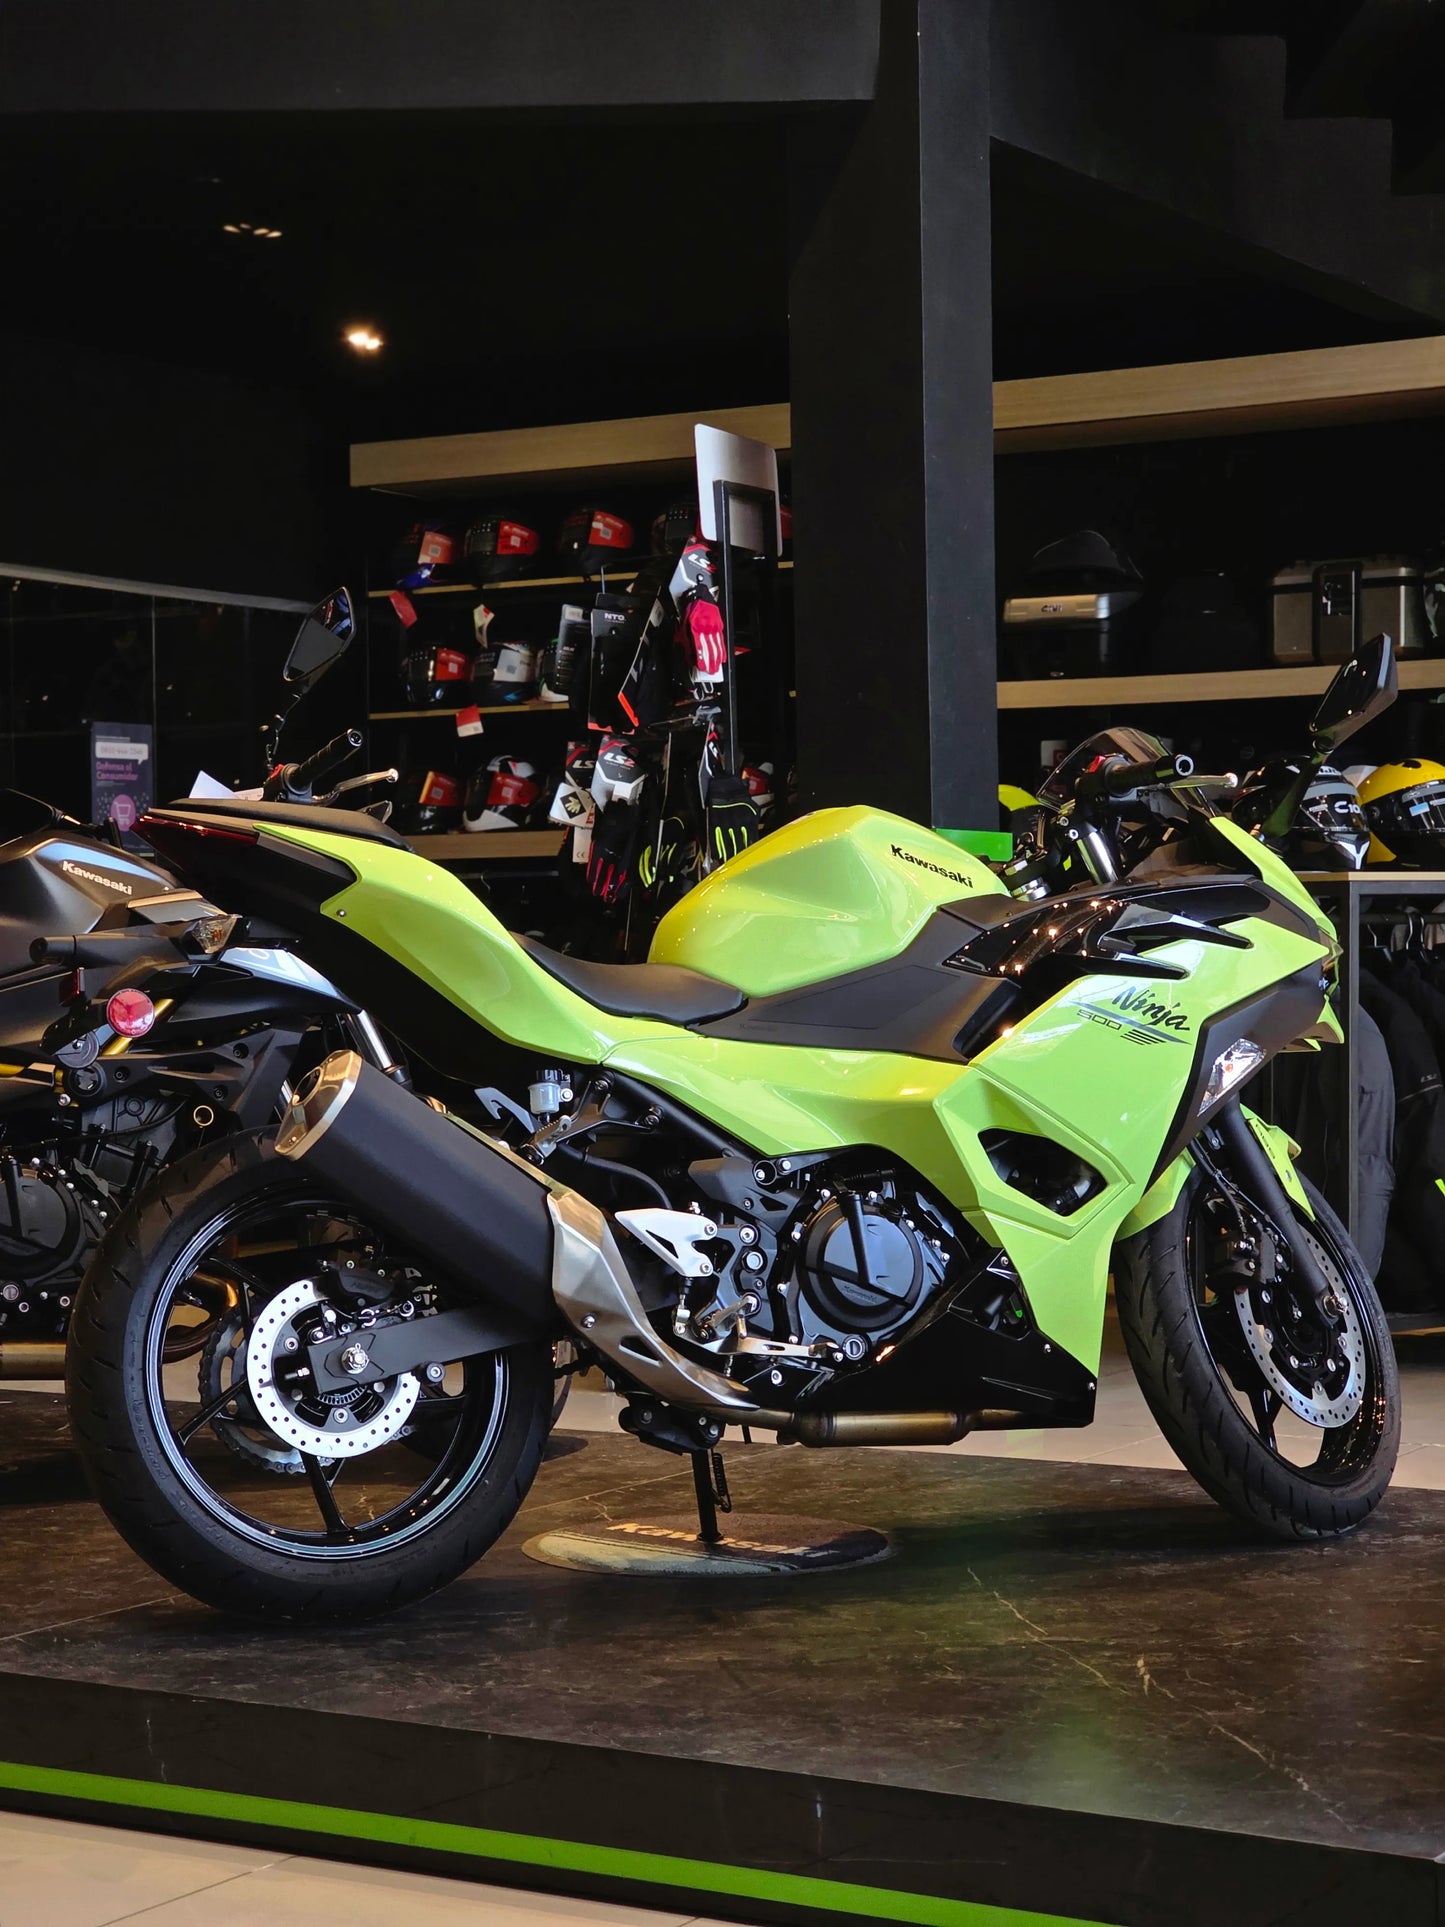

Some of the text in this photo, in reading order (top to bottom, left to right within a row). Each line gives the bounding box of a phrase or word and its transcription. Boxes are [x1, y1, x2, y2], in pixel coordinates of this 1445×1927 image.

[572, 759, 595, 769] LS
[603, 752, 635, 768] LS2
[1334, 800, 1361, 814] C10
[891, 844, 974, 888] Kawasaki
[62, 860, 132, 895] Kawasaki
[1111, 986, 1191, 1031] Ninja
[1077, 1009, 1122, 1031] 500
